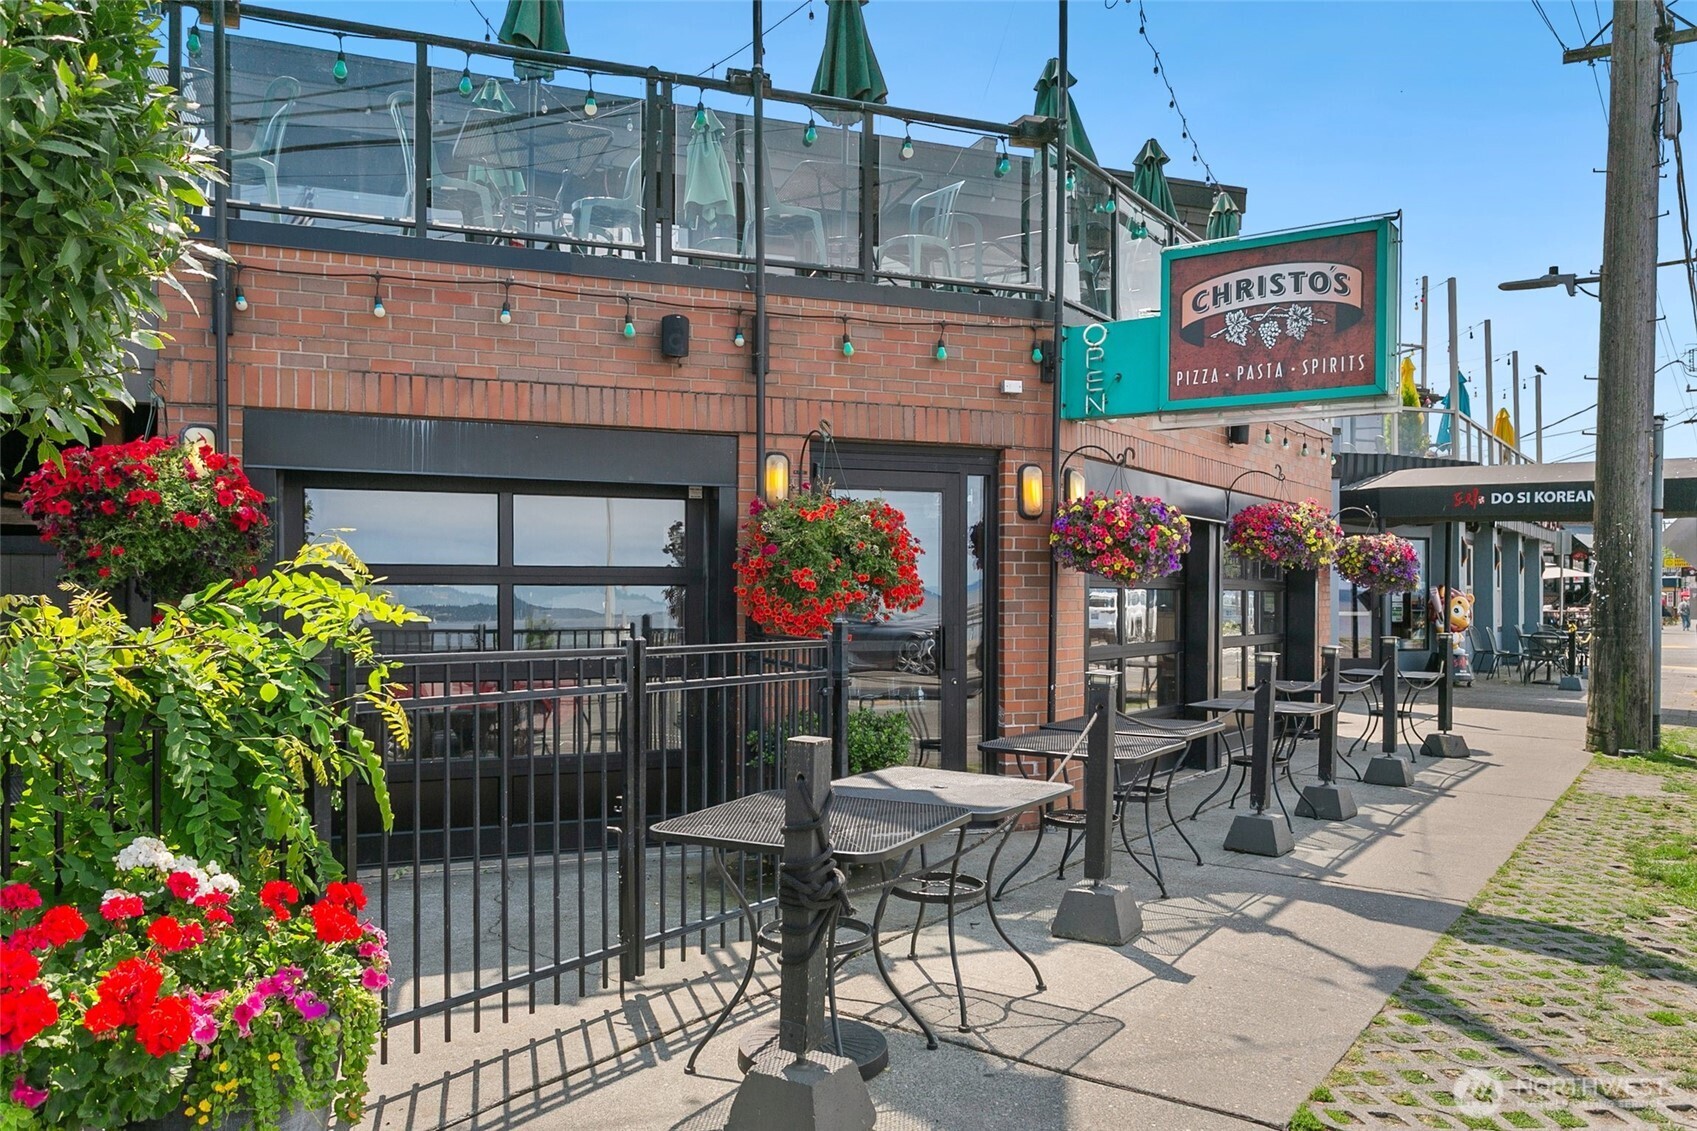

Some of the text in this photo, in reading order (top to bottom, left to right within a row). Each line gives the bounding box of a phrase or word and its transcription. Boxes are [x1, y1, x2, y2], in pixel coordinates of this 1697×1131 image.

[1191, 265, 1352, 313] CHRISTO'S
[1083, 323, 1107, 415] OPEN
[1176, 353, 1366, 386] PIZZA PASTA SPIRITS
[1491, 490, 1595, 505] DO SI KOREAN
